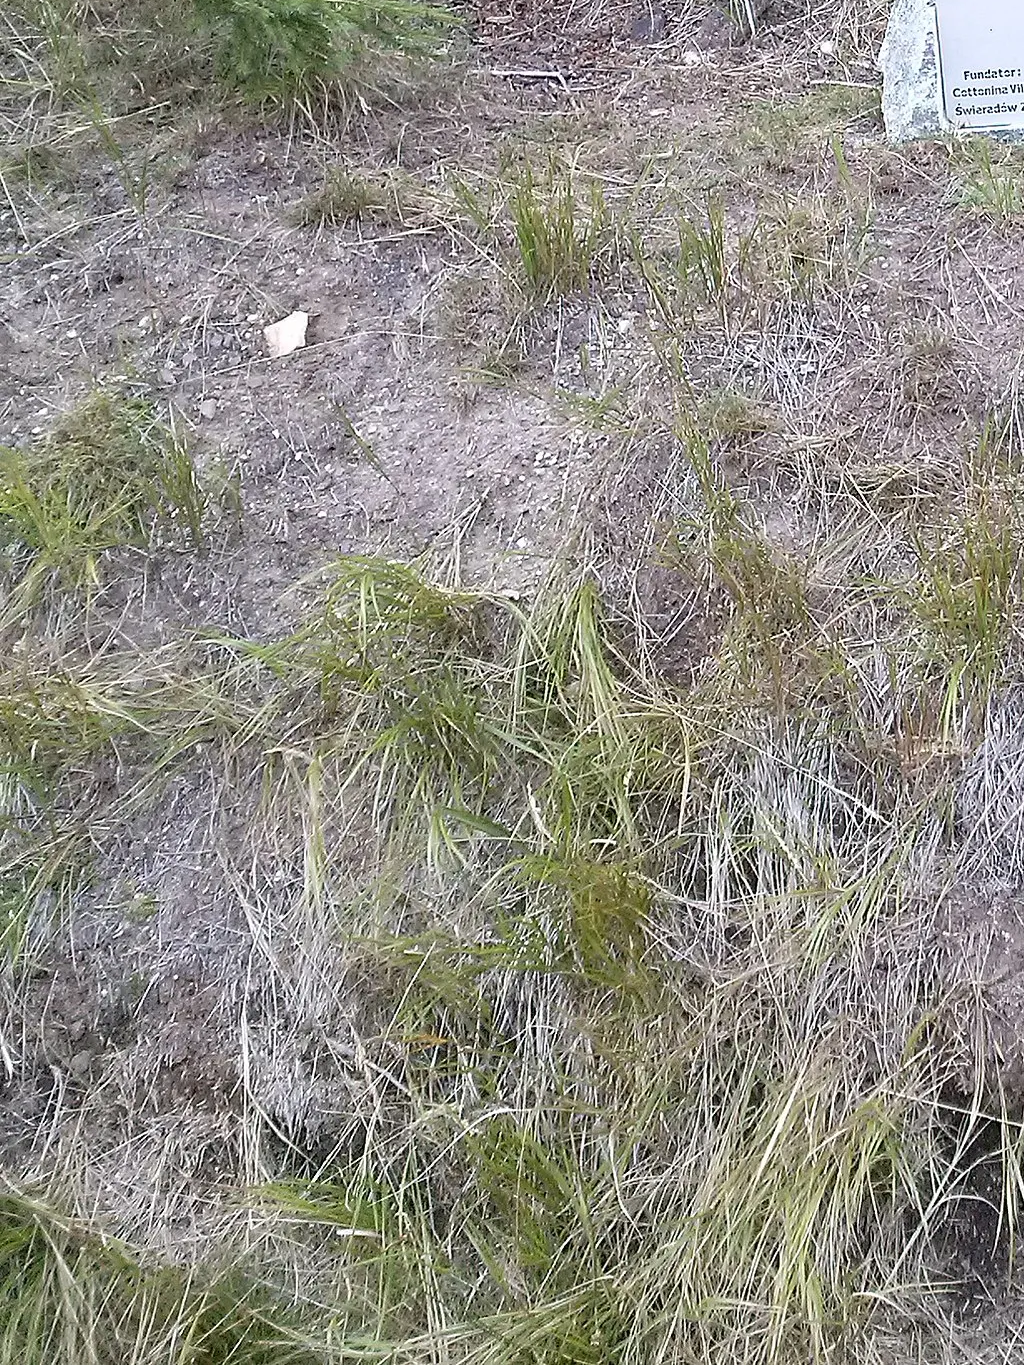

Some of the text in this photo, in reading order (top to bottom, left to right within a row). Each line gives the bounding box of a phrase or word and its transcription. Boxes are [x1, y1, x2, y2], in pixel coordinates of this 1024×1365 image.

[964, 69, 1022, 80] Fundator:
[953, 83, 1008, 97] Cottonina
[955, 101, 1017, 116] Świeradów
